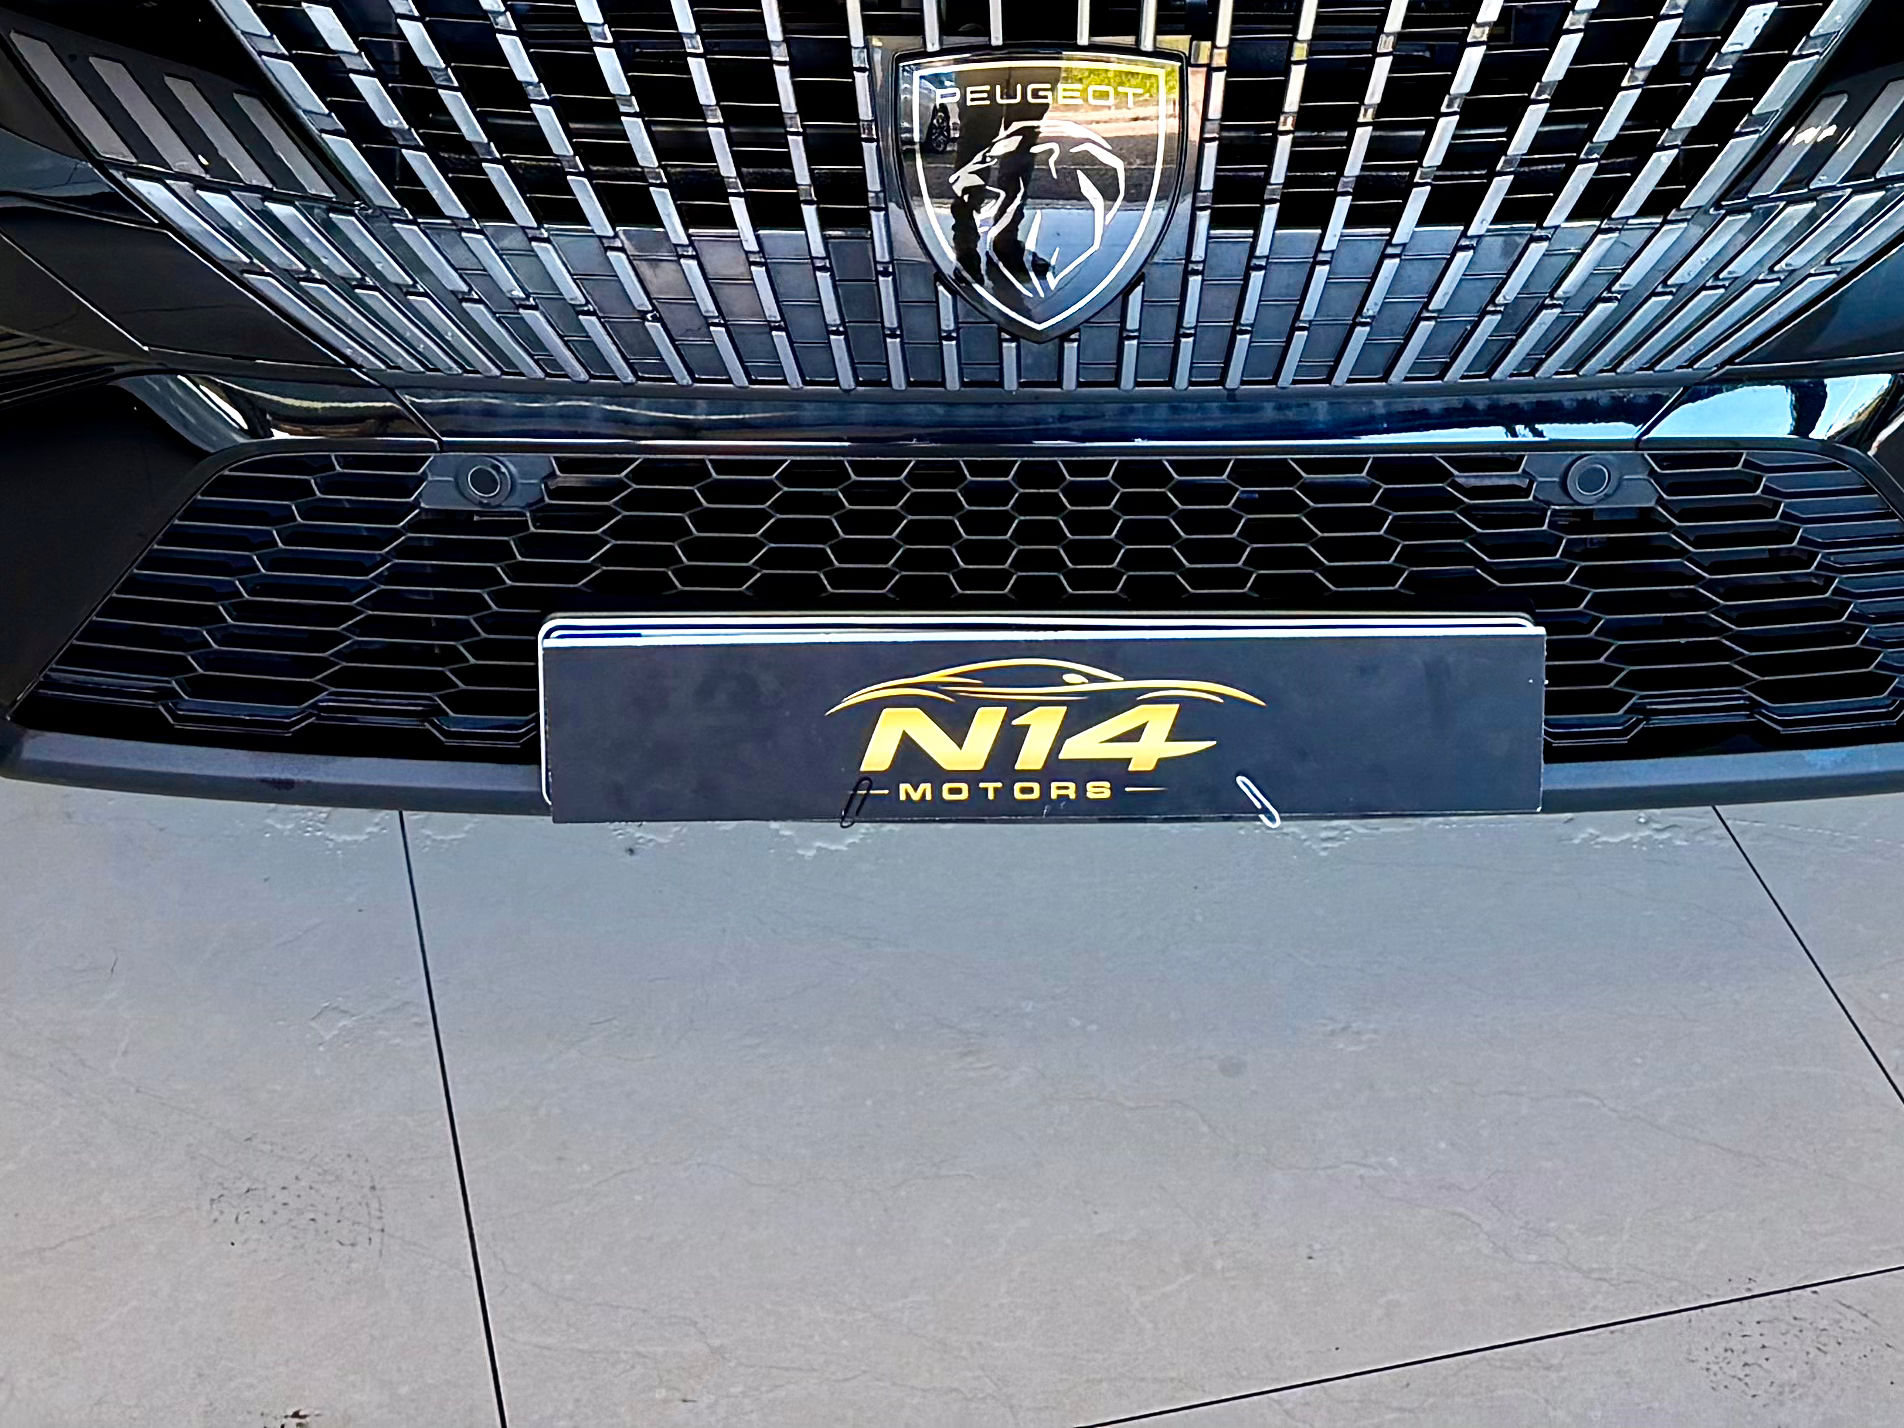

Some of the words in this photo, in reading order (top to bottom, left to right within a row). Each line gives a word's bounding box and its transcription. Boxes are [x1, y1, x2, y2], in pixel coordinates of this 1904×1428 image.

[935, 84, 1144, 107] PEUGEOT
[859, 703, 1217, 772] N14
[899, 781, 1113, 801] MOTORS
